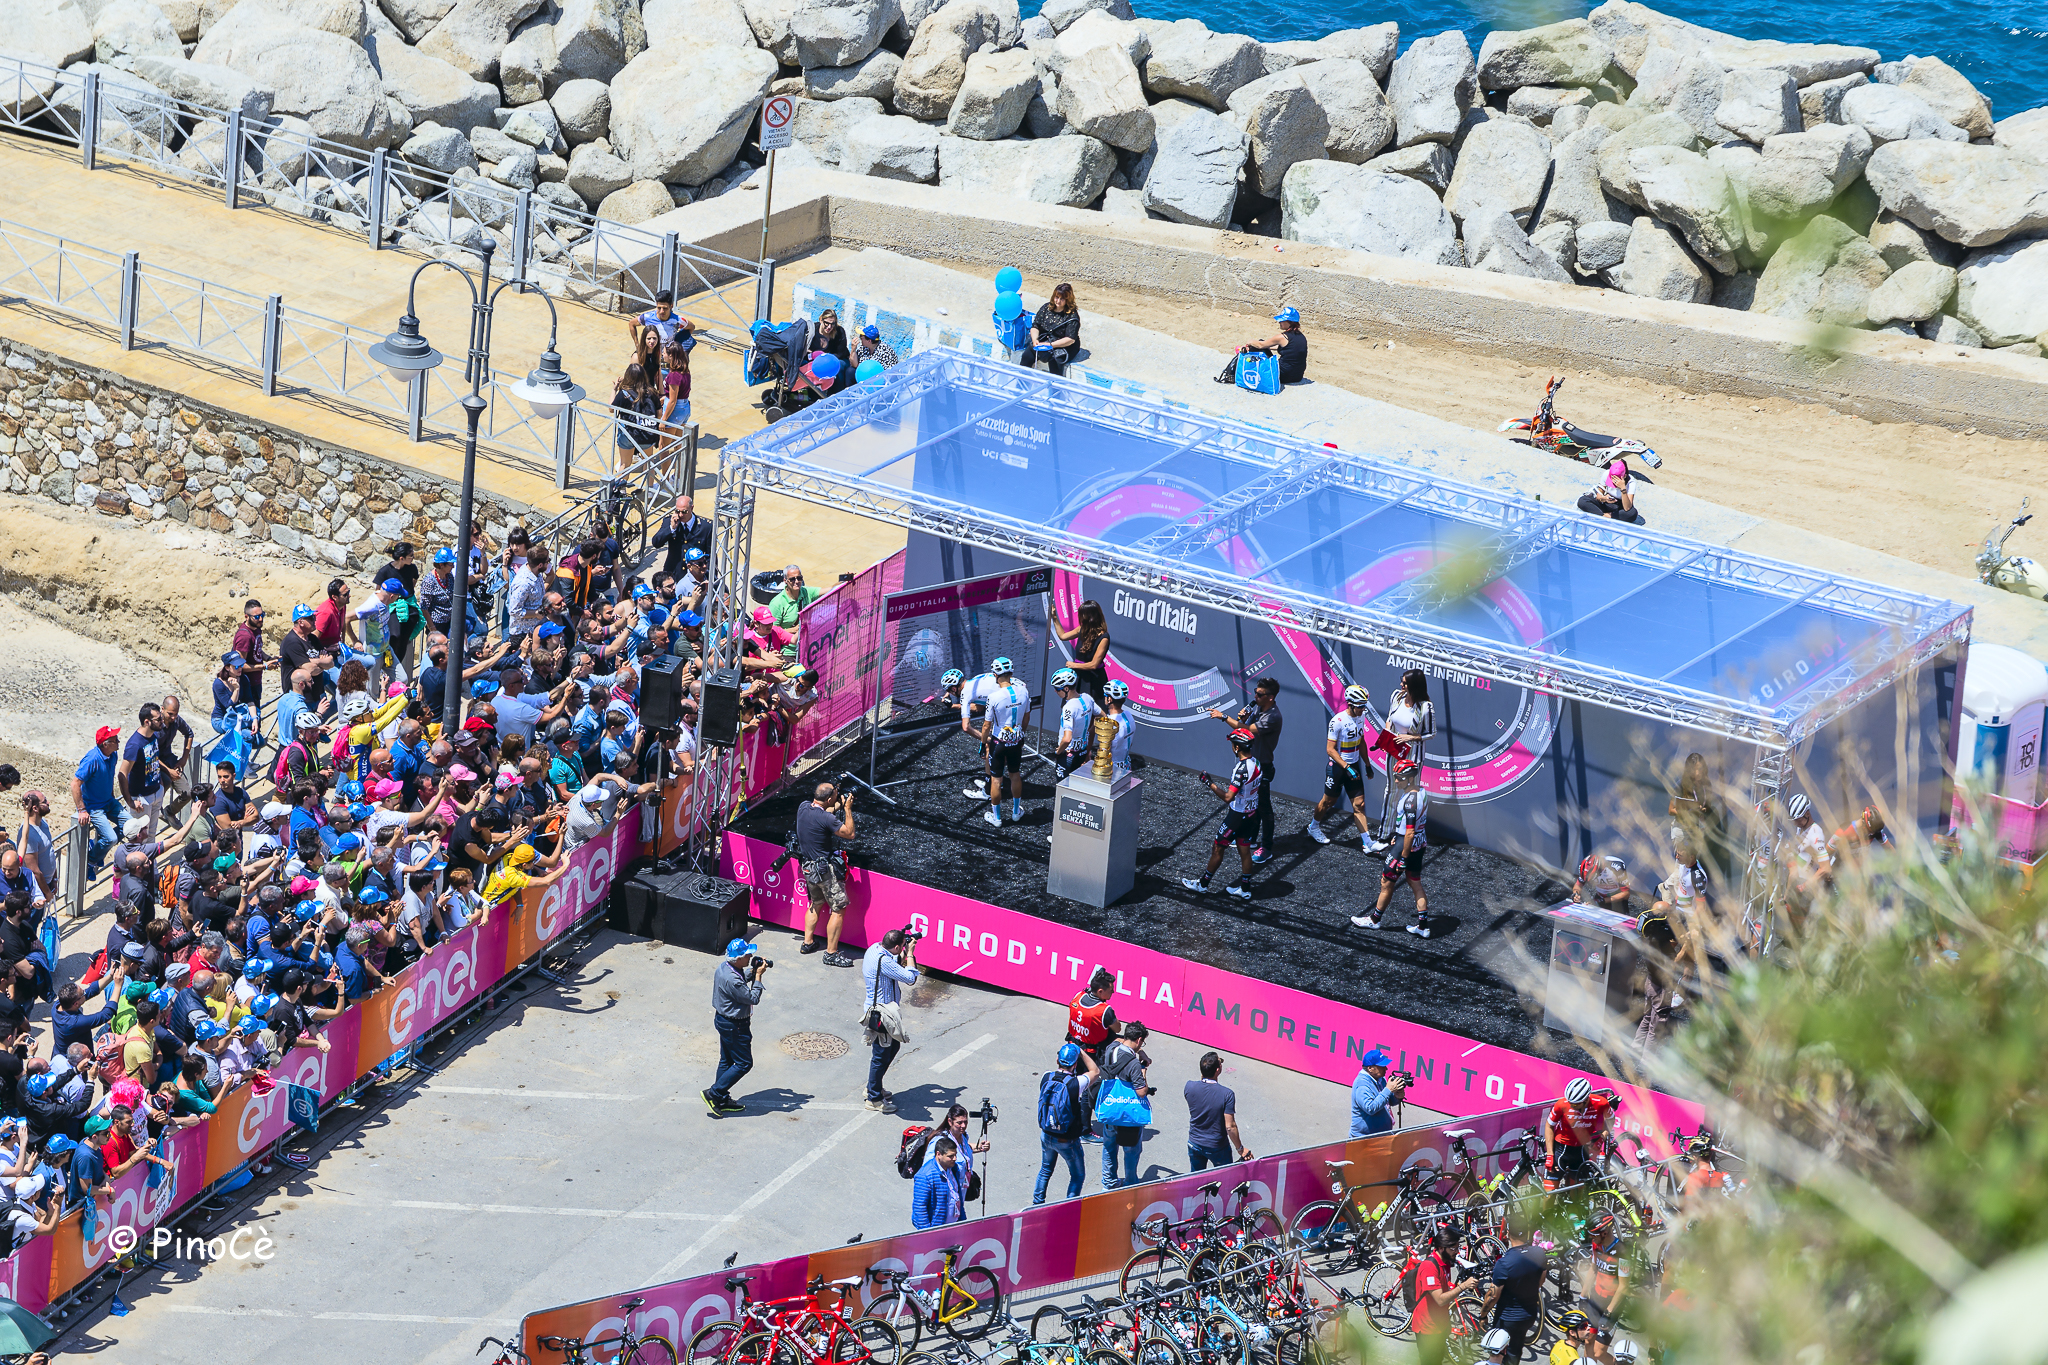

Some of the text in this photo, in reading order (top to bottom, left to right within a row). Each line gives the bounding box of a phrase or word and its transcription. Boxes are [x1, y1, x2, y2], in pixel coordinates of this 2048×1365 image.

[1010, 422, 1028, 438] dello
[1028, 426, 1051, 445] Sport
[982, 448, 999, 460] UCI
[1113, 589, 1198, 635] Giro d'Italia
[807, 613, 850, 667] enel
[1245, 659, 1267, 676] START
[1484, 754, 1493, 762] 15
[2020, 753, 2034, 770] TOI
[1062, 813, 1099, 829] SENZA FINE
[1069, 809, 1093, 822] TROFEO
[536, 822, 618, 941] enel
[388, 925, 479, 1045] enel
[1076, 1011, 1083, 1022] 3
[1131, 1159, 1288, 1254] enel
[861, 1218, 1023, 1315] enel
[784, 1323, 819, 1360] TREK
